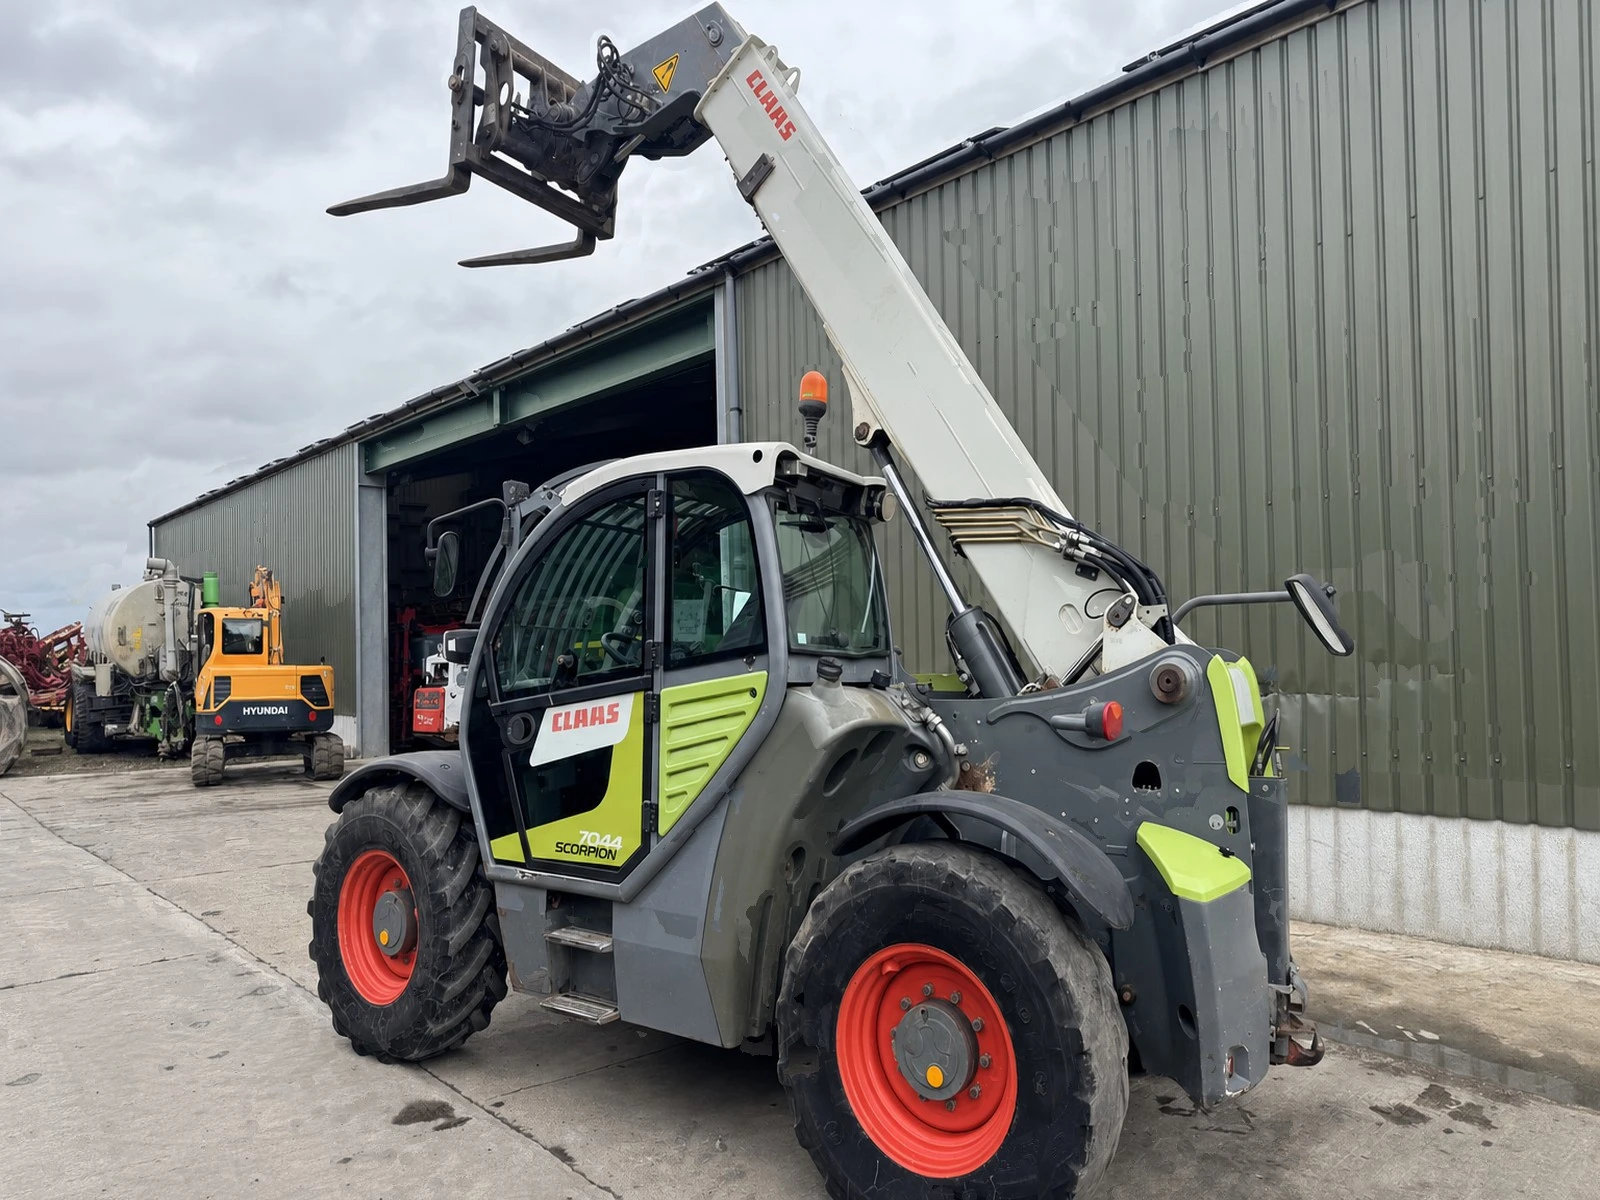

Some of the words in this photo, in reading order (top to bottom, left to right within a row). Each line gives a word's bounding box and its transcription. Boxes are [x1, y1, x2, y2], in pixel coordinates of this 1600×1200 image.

[745, 69, 797, 142] CLAAS
[242, 706, 288, 716] HYUNDAI
[552, 702, 620, 732] CLAAS
[579, 830, 623, 849] 7044
[554, 841, 618, 861] SCORPION
